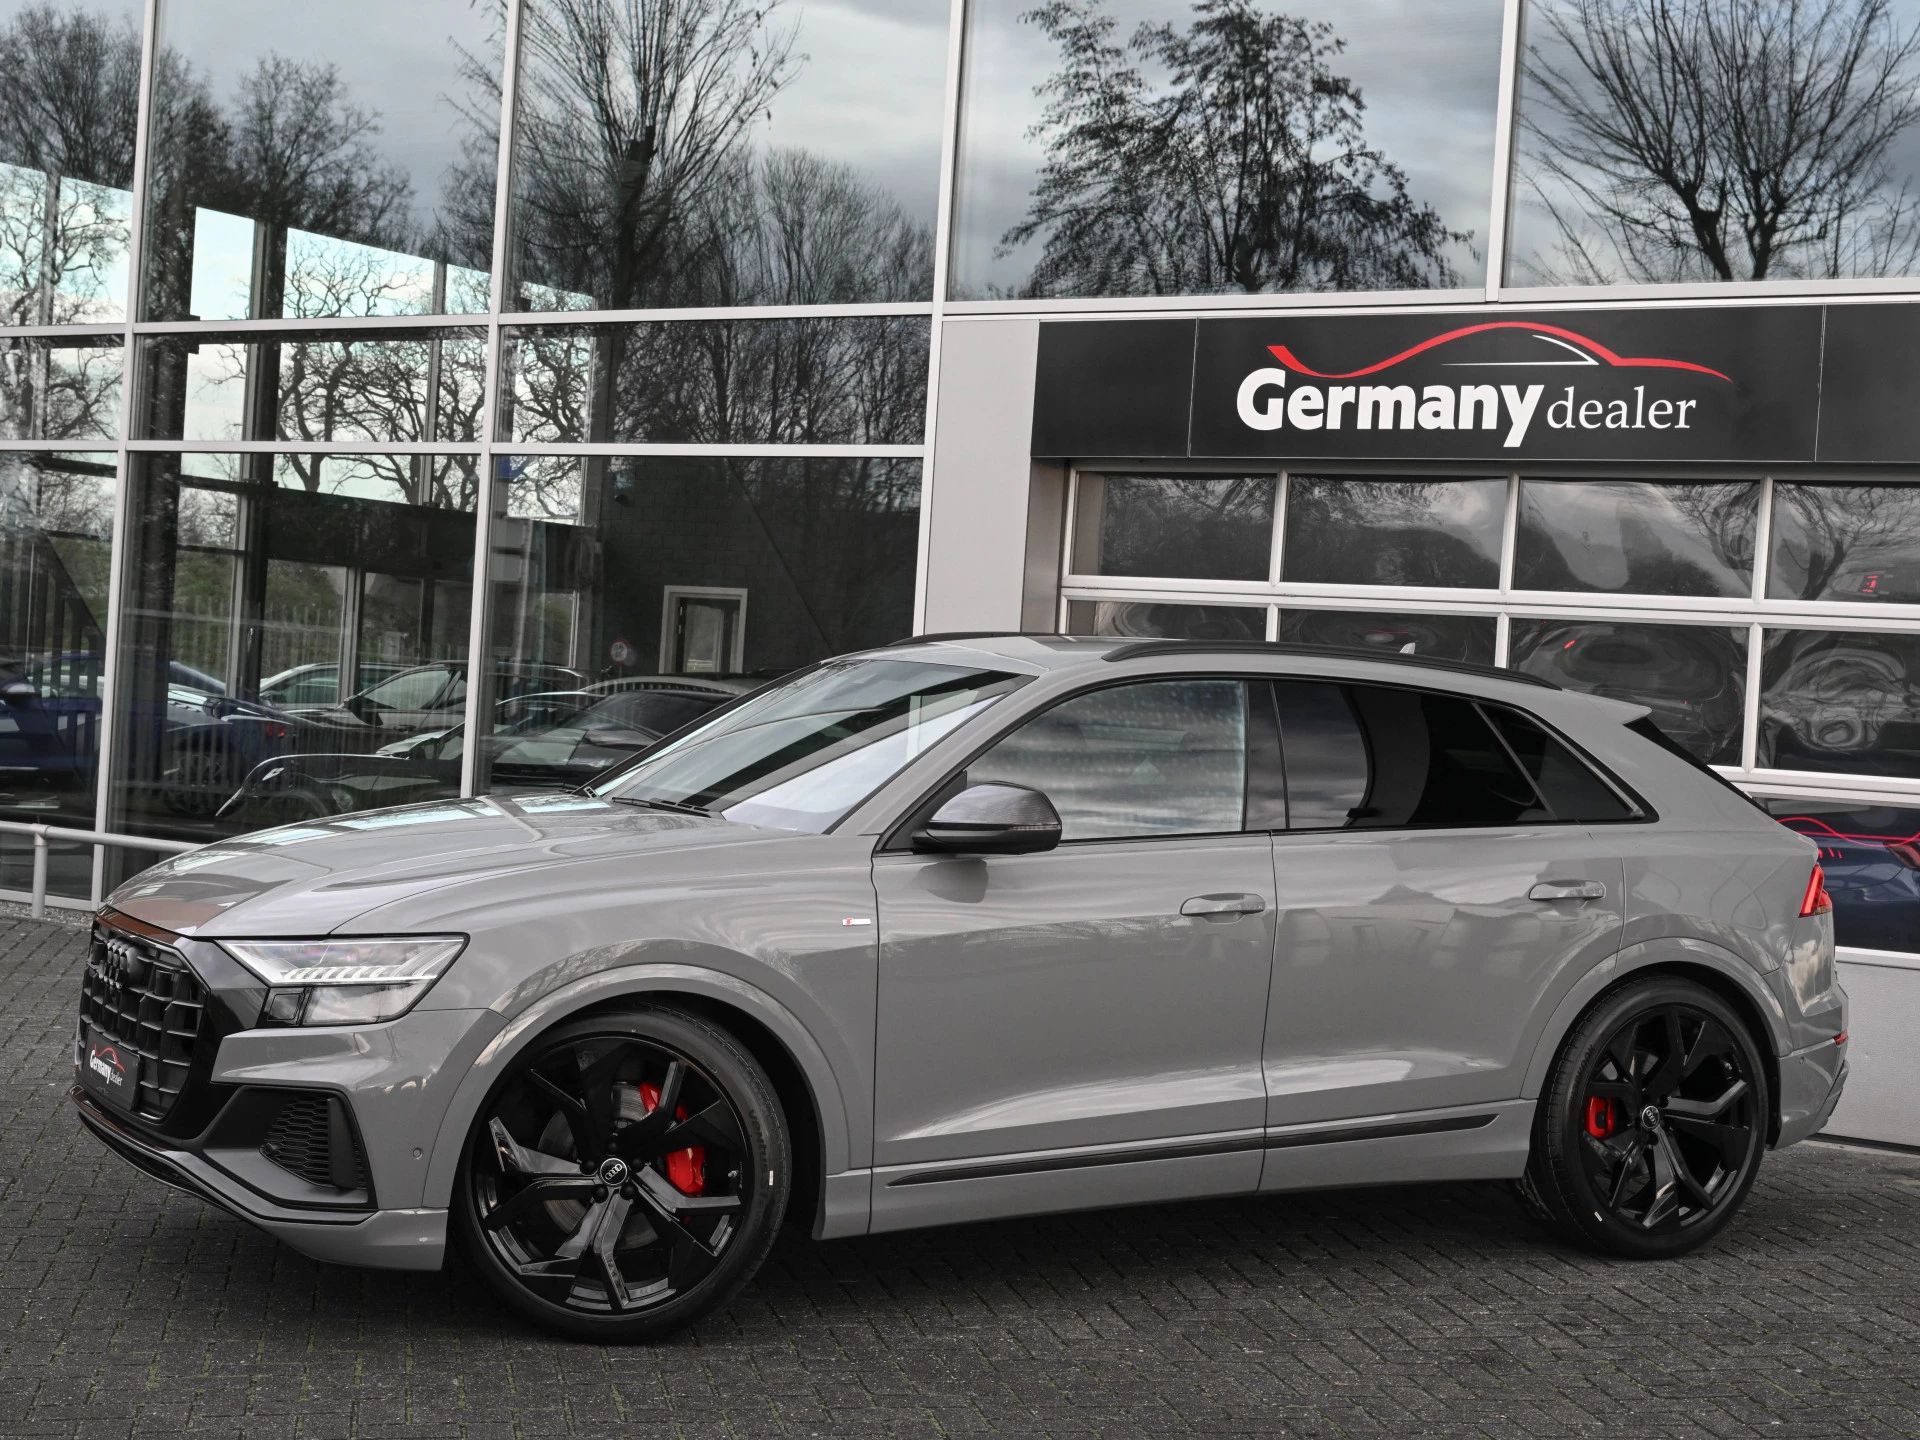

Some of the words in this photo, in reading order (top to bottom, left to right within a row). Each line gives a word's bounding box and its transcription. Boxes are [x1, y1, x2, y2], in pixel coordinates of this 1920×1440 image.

[1237, 367, 1545, 448] Germany
[1546, 386, 1697, 429] dealer
[89, 1049, 112, 1084] Germany
